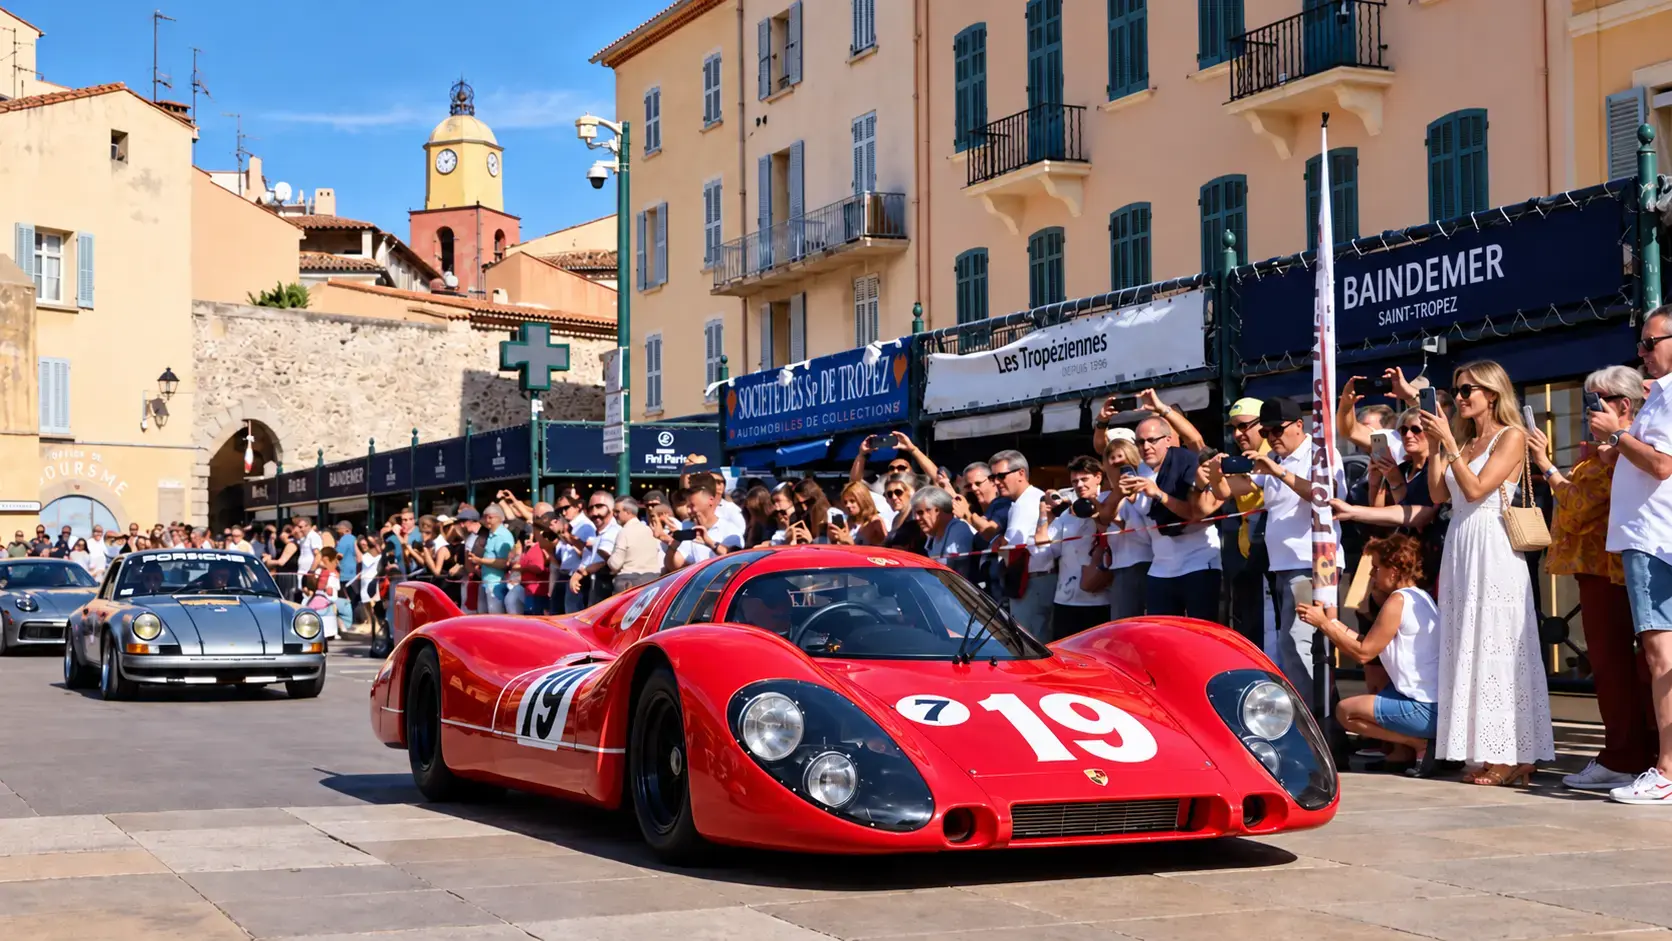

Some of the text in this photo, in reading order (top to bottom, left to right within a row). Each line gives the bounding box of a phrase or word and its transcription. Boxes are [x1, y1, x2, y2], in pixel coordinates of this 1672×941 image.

[1344, 244, 1504, 310] BAINDEMER
[1378, 296, 1458, 327] SAINT-TROPEZ
[993, 333, 1108, 374] Les Tropéziennes
[820, 368, 837, 405] DE
[737, 419, 803, 438] AUTOMOBILES
[806, 416, 818, 428] DE
[521, 666, 598, 740] 19
[914, 699, 951, 722] 7
[977, 693, 1159, 763] 19
